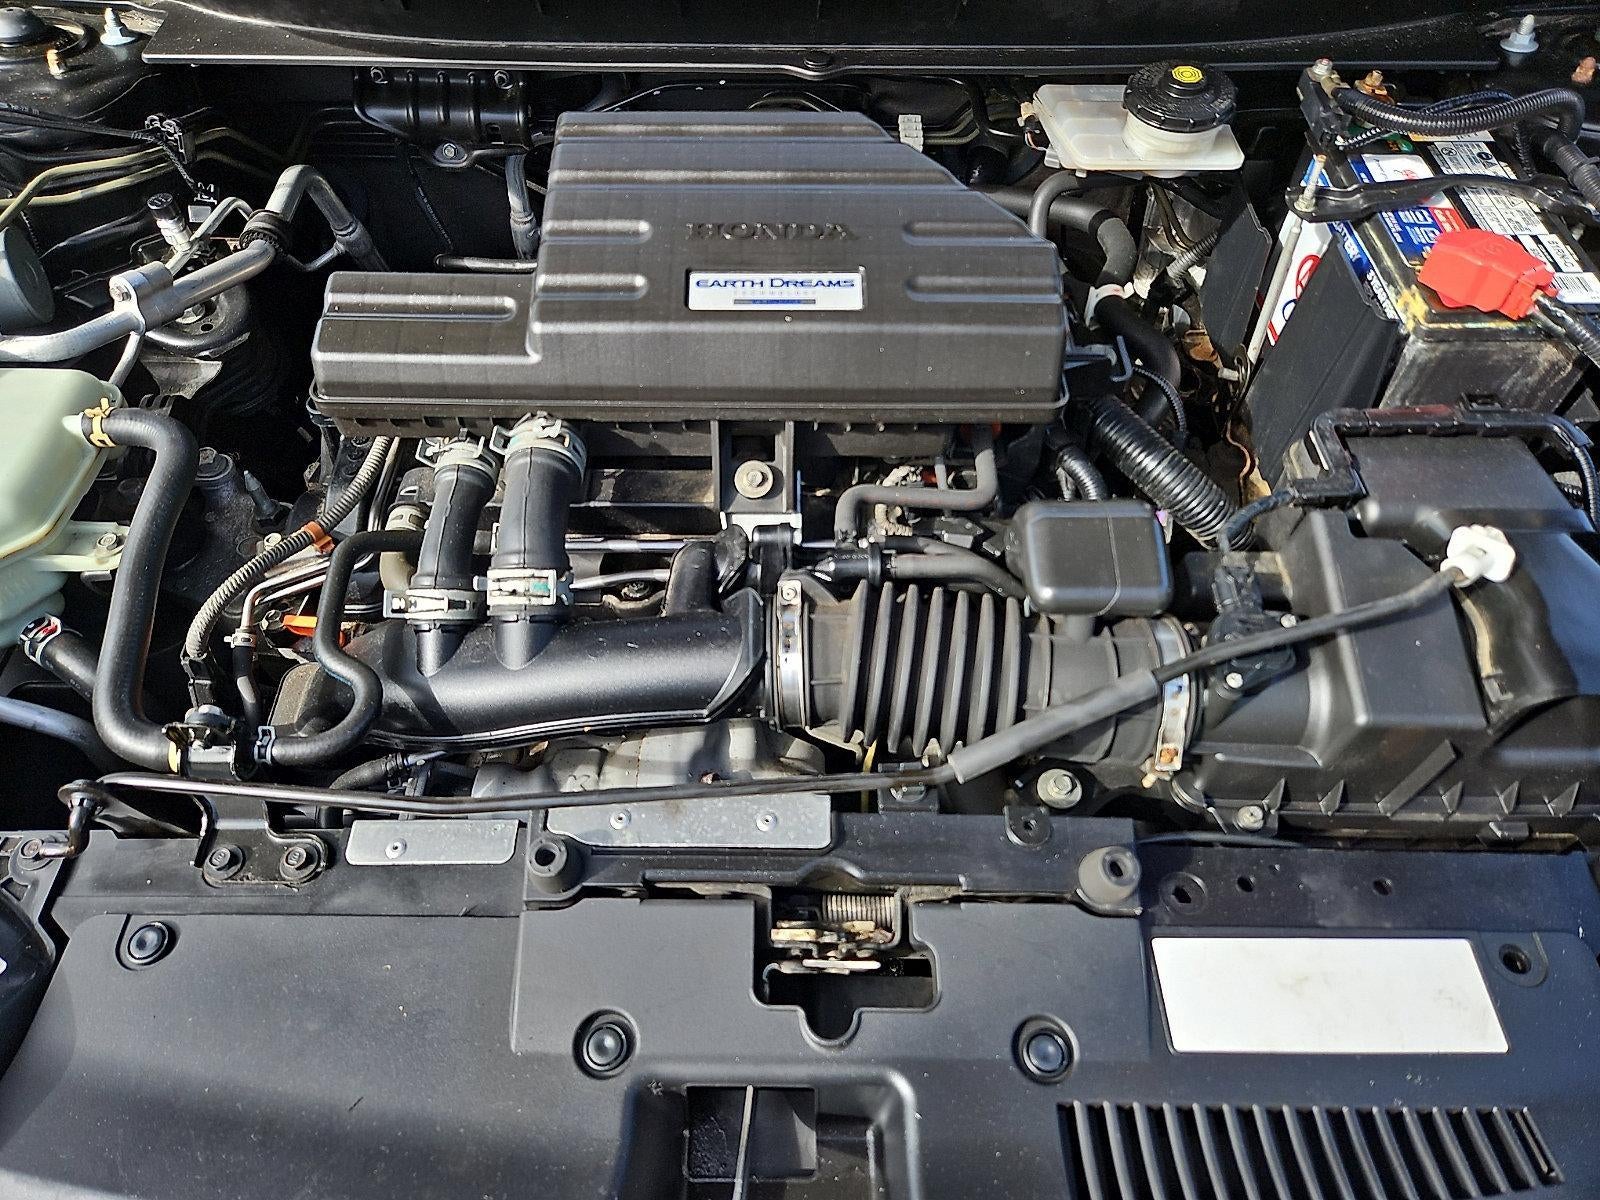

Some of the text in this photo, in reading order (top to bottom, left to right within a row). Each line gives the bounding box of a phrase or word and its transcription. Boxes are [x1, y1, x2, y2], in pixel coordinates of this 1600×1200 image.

[686, 223, 857, 240] HONDA
[695, 277, 855, 288] EARTH DREAMS
